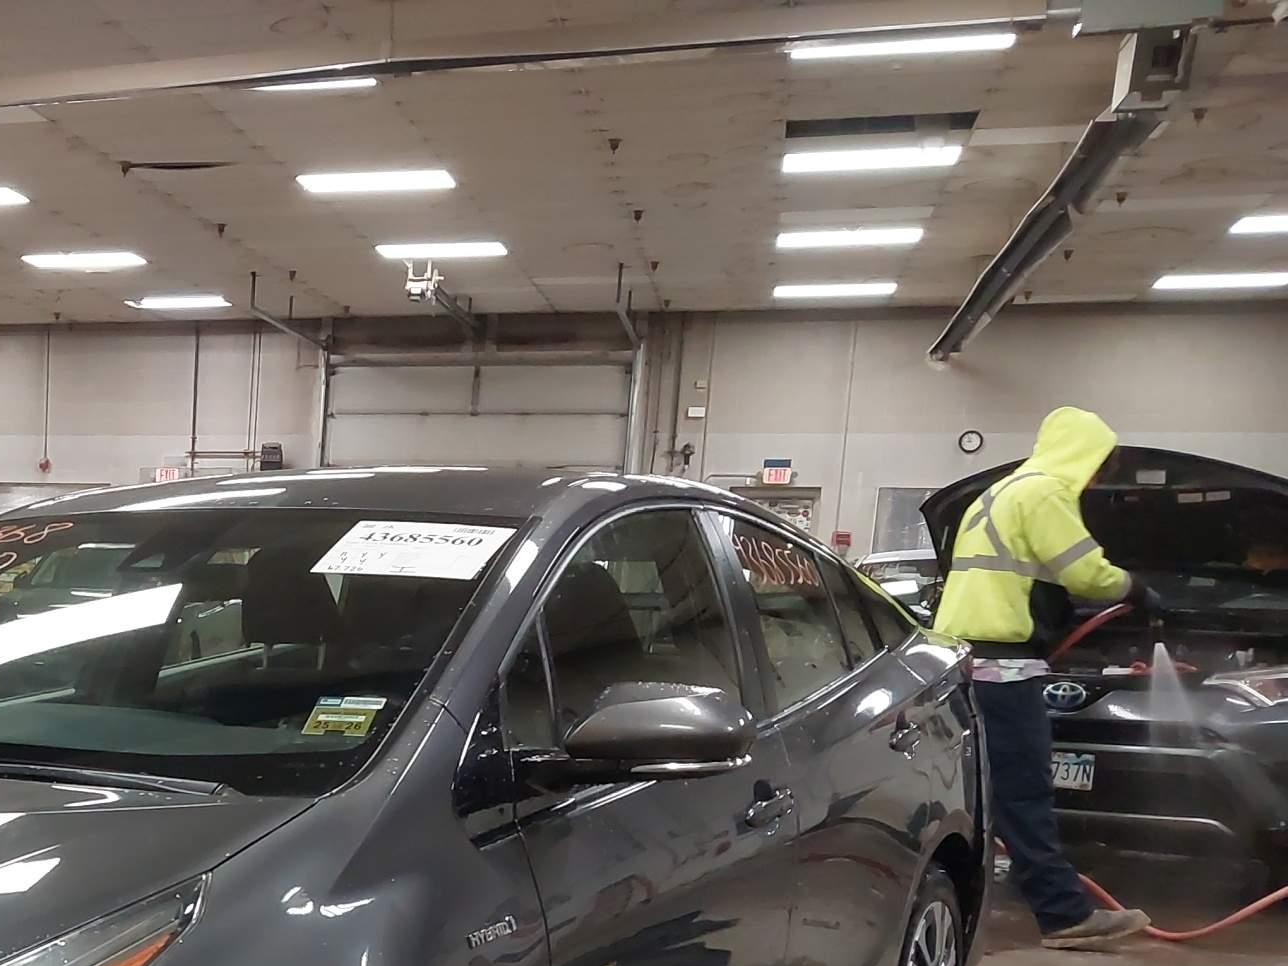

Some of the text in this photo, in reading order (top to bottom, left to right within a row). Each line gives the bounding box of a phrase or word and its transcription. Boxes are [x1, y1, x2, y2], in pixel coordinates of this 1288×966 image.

[160, 469, 176, 481] EXIT
[768, 468, 788, 482] EXIT
[360, 531, 484, 547] 43685560
[313, 721, 361, 730] 25 26
[467, 915, 517, 949] HYBRID
